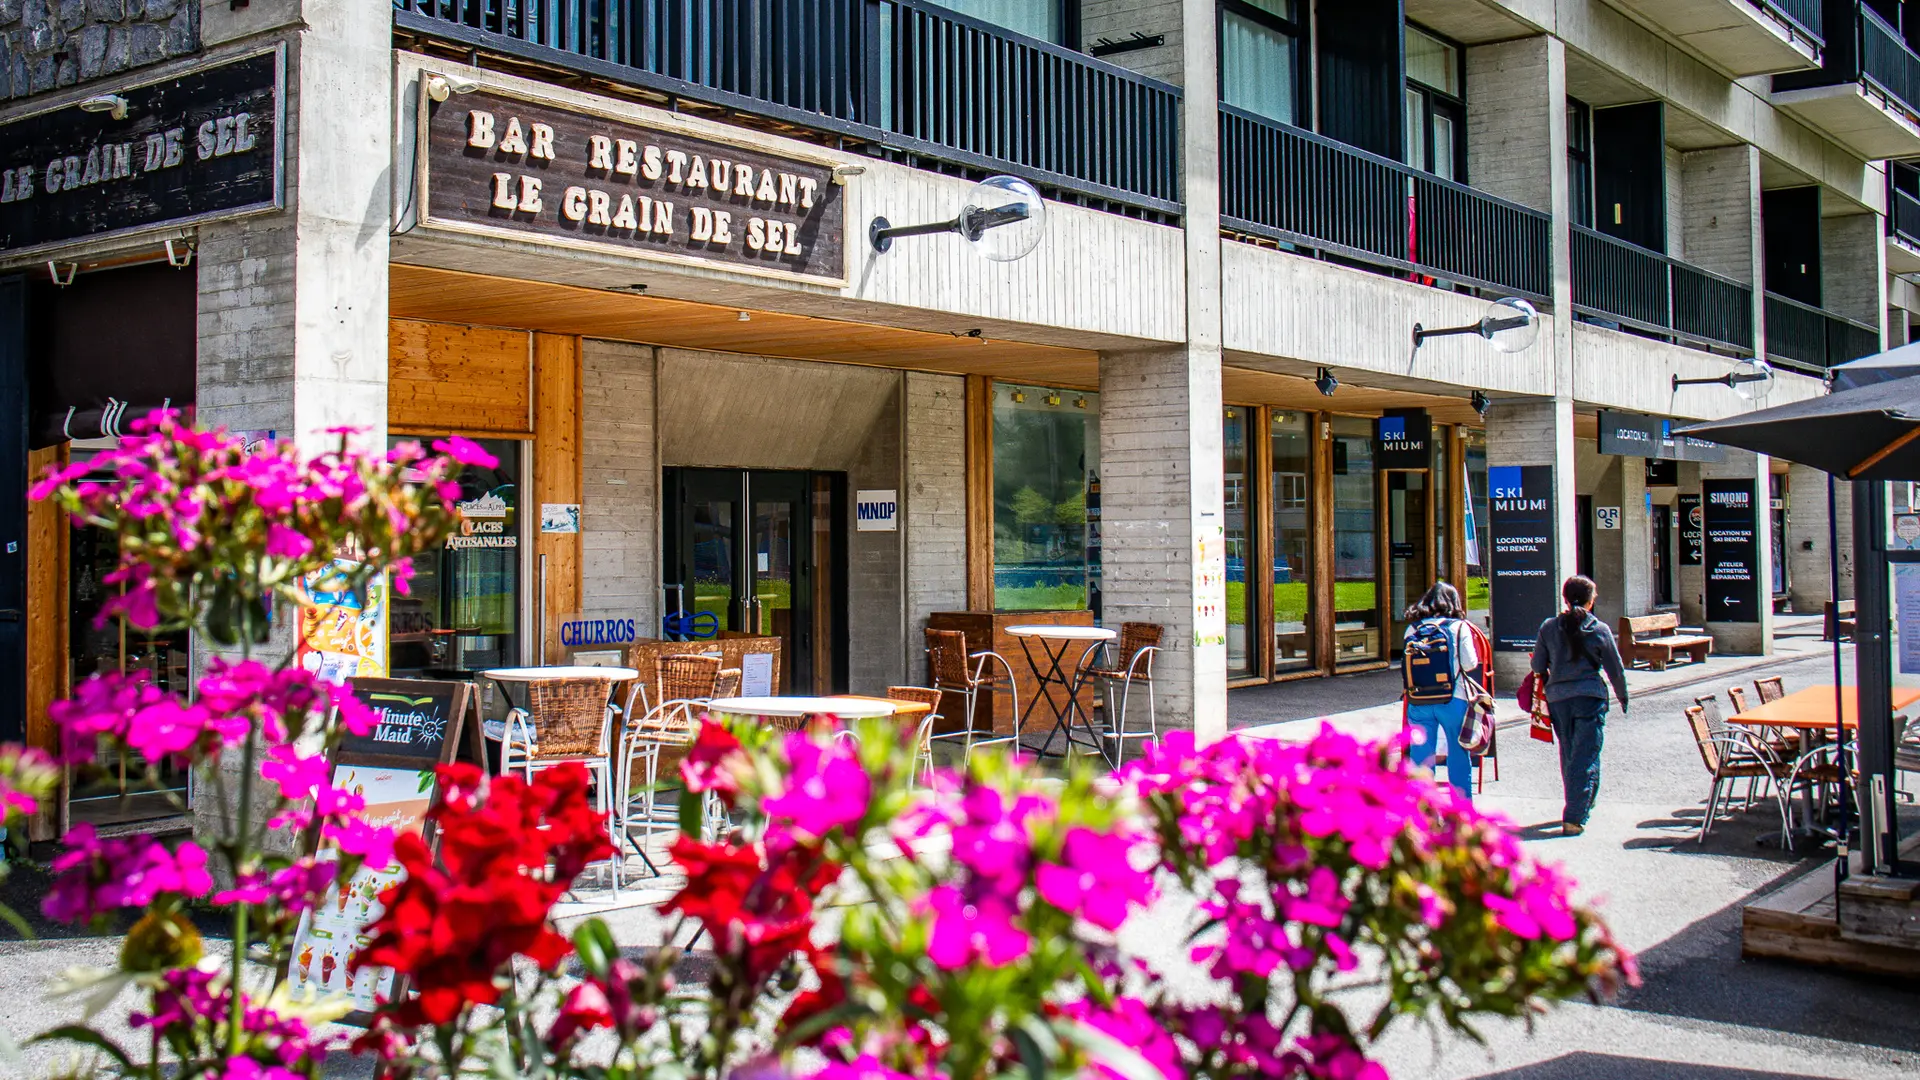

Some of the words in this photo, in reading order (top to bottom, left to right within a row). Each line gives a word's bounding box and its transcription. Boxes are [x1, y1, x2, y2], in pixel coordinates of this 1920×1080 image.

[1, 165, 34, 202] LE
[45, 141, 134, 195] GRAIN
[143, 126, 185, 172] DE
[197, 112, 256, 161] SEL
[468, 109, 556, 161] BAR
[587, 134, 818, 208] RESTAURANT
[492, 172, 544, 213] LE
[562, 186, 674, 235] GRAIN
[690, 206, 732, 245] DE
[746, 216, 802, 256] SEL
[1384, 431, 1406, 441] SKI
[1495, 486, 1523, 499] SKI
[1710, 492, 1749, 504] SIMOND
[460, 519, 504, 537] GLACES
[444, 532, 517, 551] ARTISANALES
[1534, 536, 1547, 544] SKI
[561, 618, 635, 647] CHURROS
[373, 705, 423, 726] Minute
[373, 723, 413, 744] Maid
